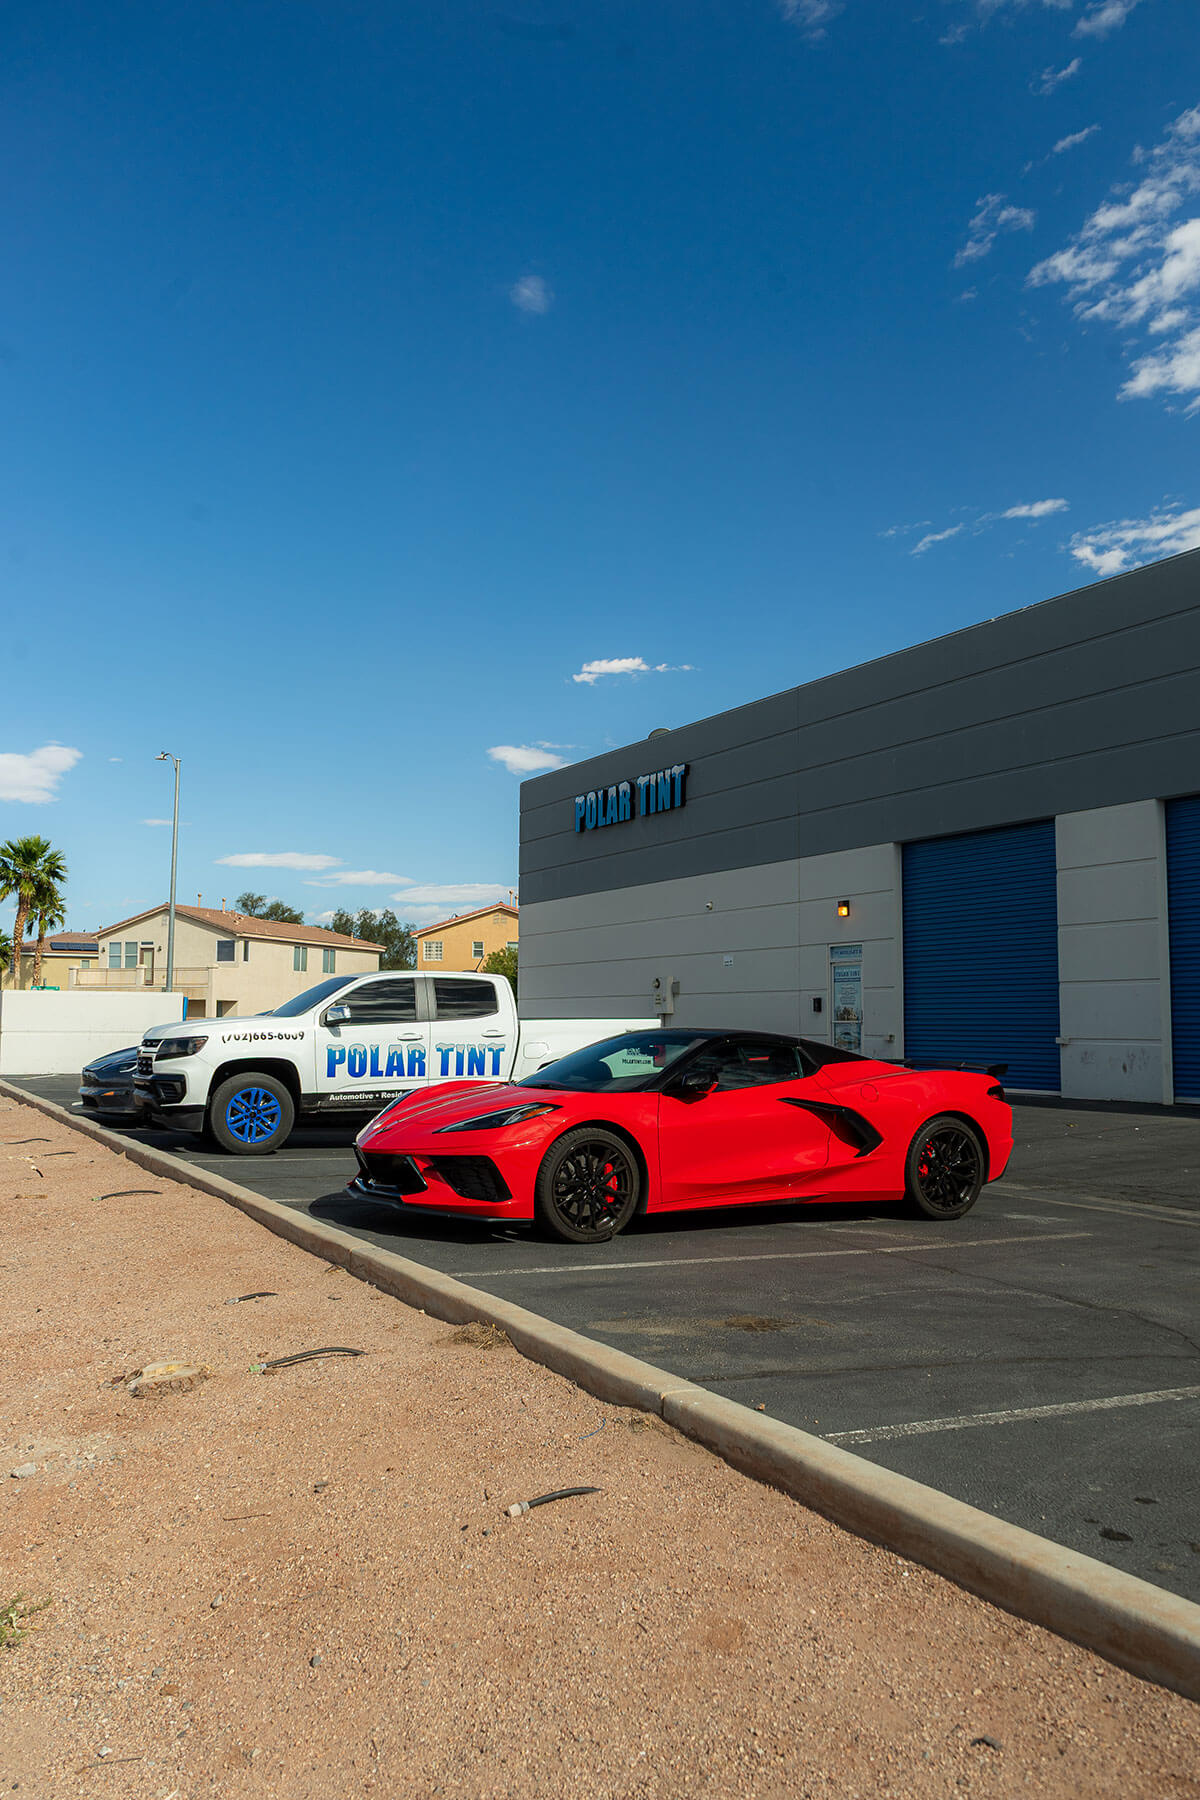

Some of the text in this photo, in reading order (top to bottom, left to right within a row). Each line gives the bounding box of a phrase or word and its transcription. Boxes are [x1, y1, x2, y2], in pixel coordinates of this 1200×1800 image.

[575, 764, 687, 833] POLAR TINT
[326, 1042, 506, 1078] POLAR TINT
[329, 1091, 404, 1101] Automotive Resid
